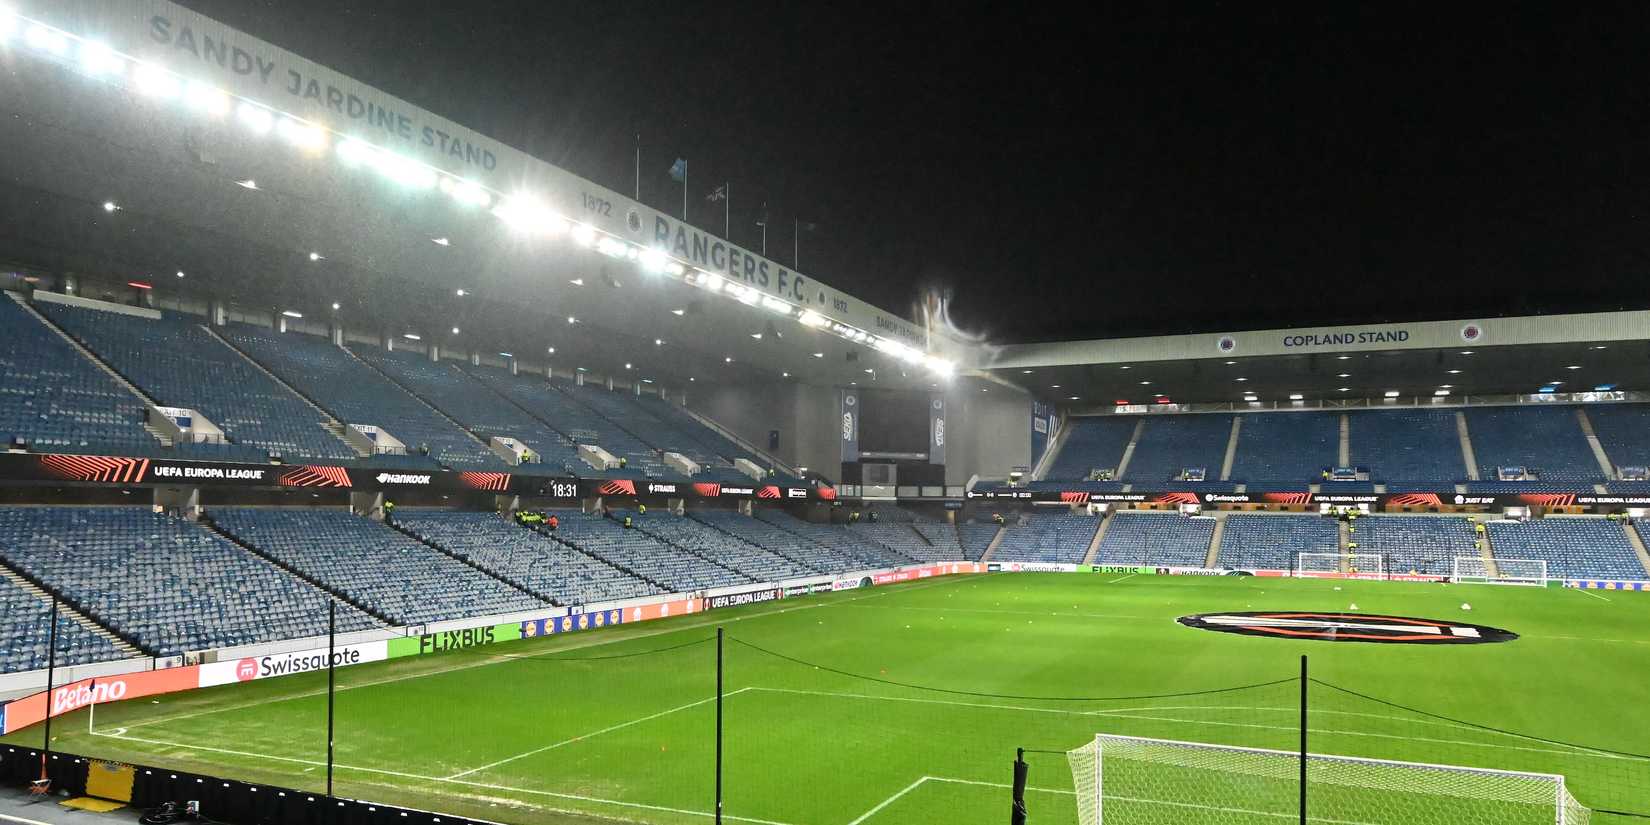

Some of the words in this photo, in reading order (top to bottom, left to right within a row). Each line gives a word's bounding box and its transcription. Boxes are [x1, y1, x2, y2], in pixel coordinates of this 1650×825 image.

[150, 15, 275, 84] SANDY
[287, 69, 412, 141] JARDINE
[421, 126, 497, 171] STAND
[582, 191, 612, 217] 1872
[655, 215, 770, 288] RANGERS
[777, 266, 810, 304] F.C.
[1283, 333, 1356, 347] COPLAND
[1358, 330, 1409, 344] STAND
[154, 466, 183, 477] UEFA
[184, 467, 225, 478] EUROPA
[225, 468, 263, 479] LEAGUE
[552, 483, 577, 497] 18:31
[653, 484, 676, 493] STRAUSS
[1213, 494, 1249, 502] Swissquote
[712, 596, 730, 608] UEFA
[730, 592, 754, 606] EUROPA
[754, 590, 776, 602] LEAGUE
[261, 648, 360, 676] Swissquote
[54, 680, 127, 713] Betano
